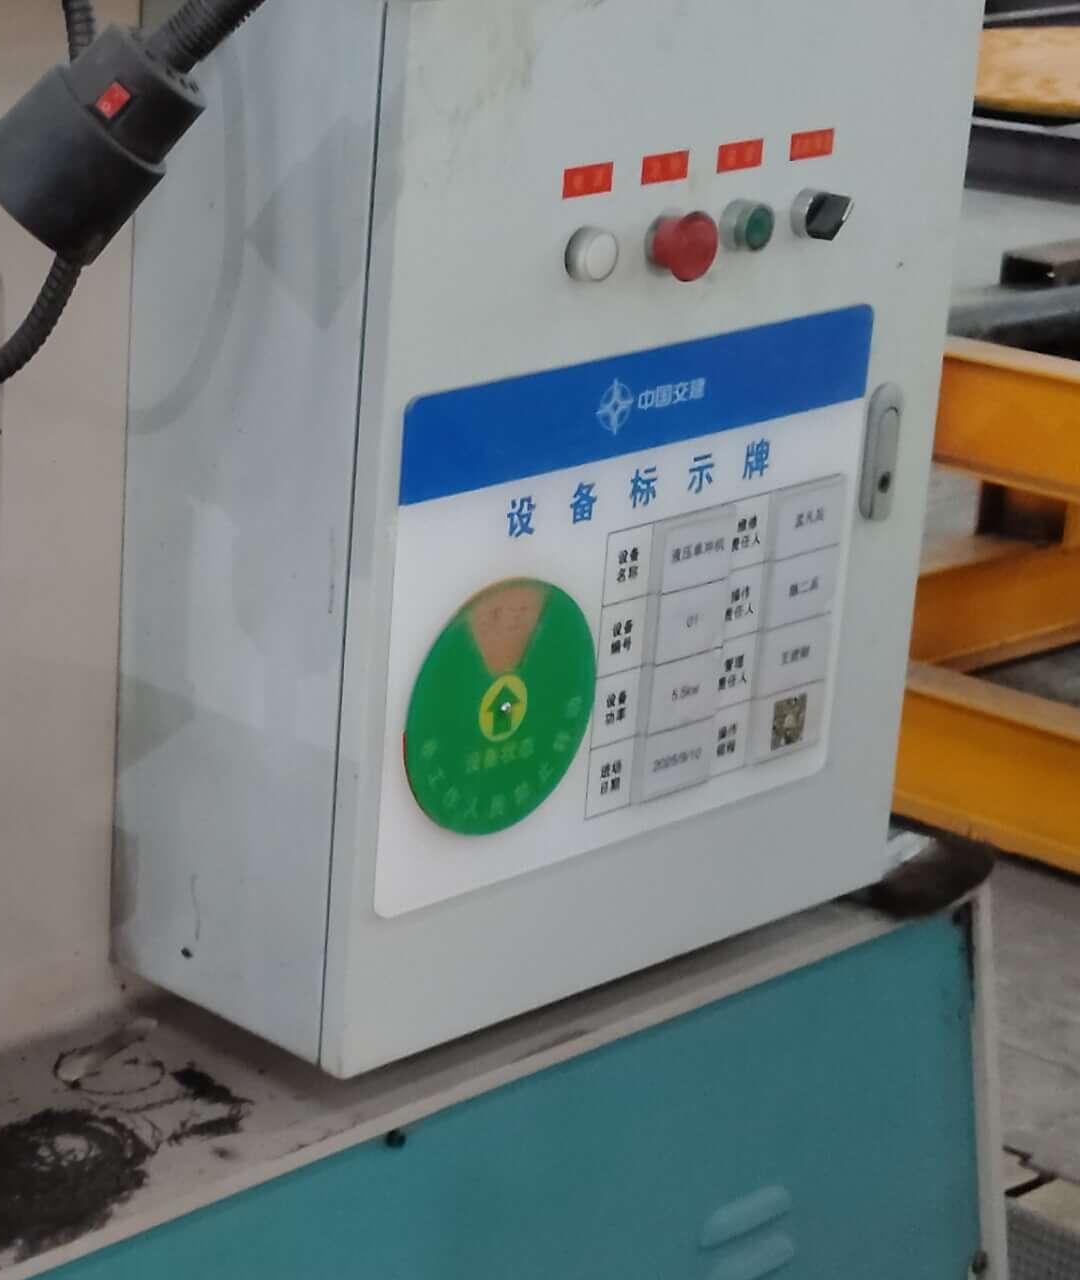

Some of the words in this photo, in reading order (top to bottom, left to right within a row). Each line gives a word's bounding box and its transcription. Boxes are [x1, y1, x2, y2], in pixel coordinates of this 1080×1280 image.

[636, 377, 707, 412] 中国交建
[506, 437, 771, 538] 设备标示牌
